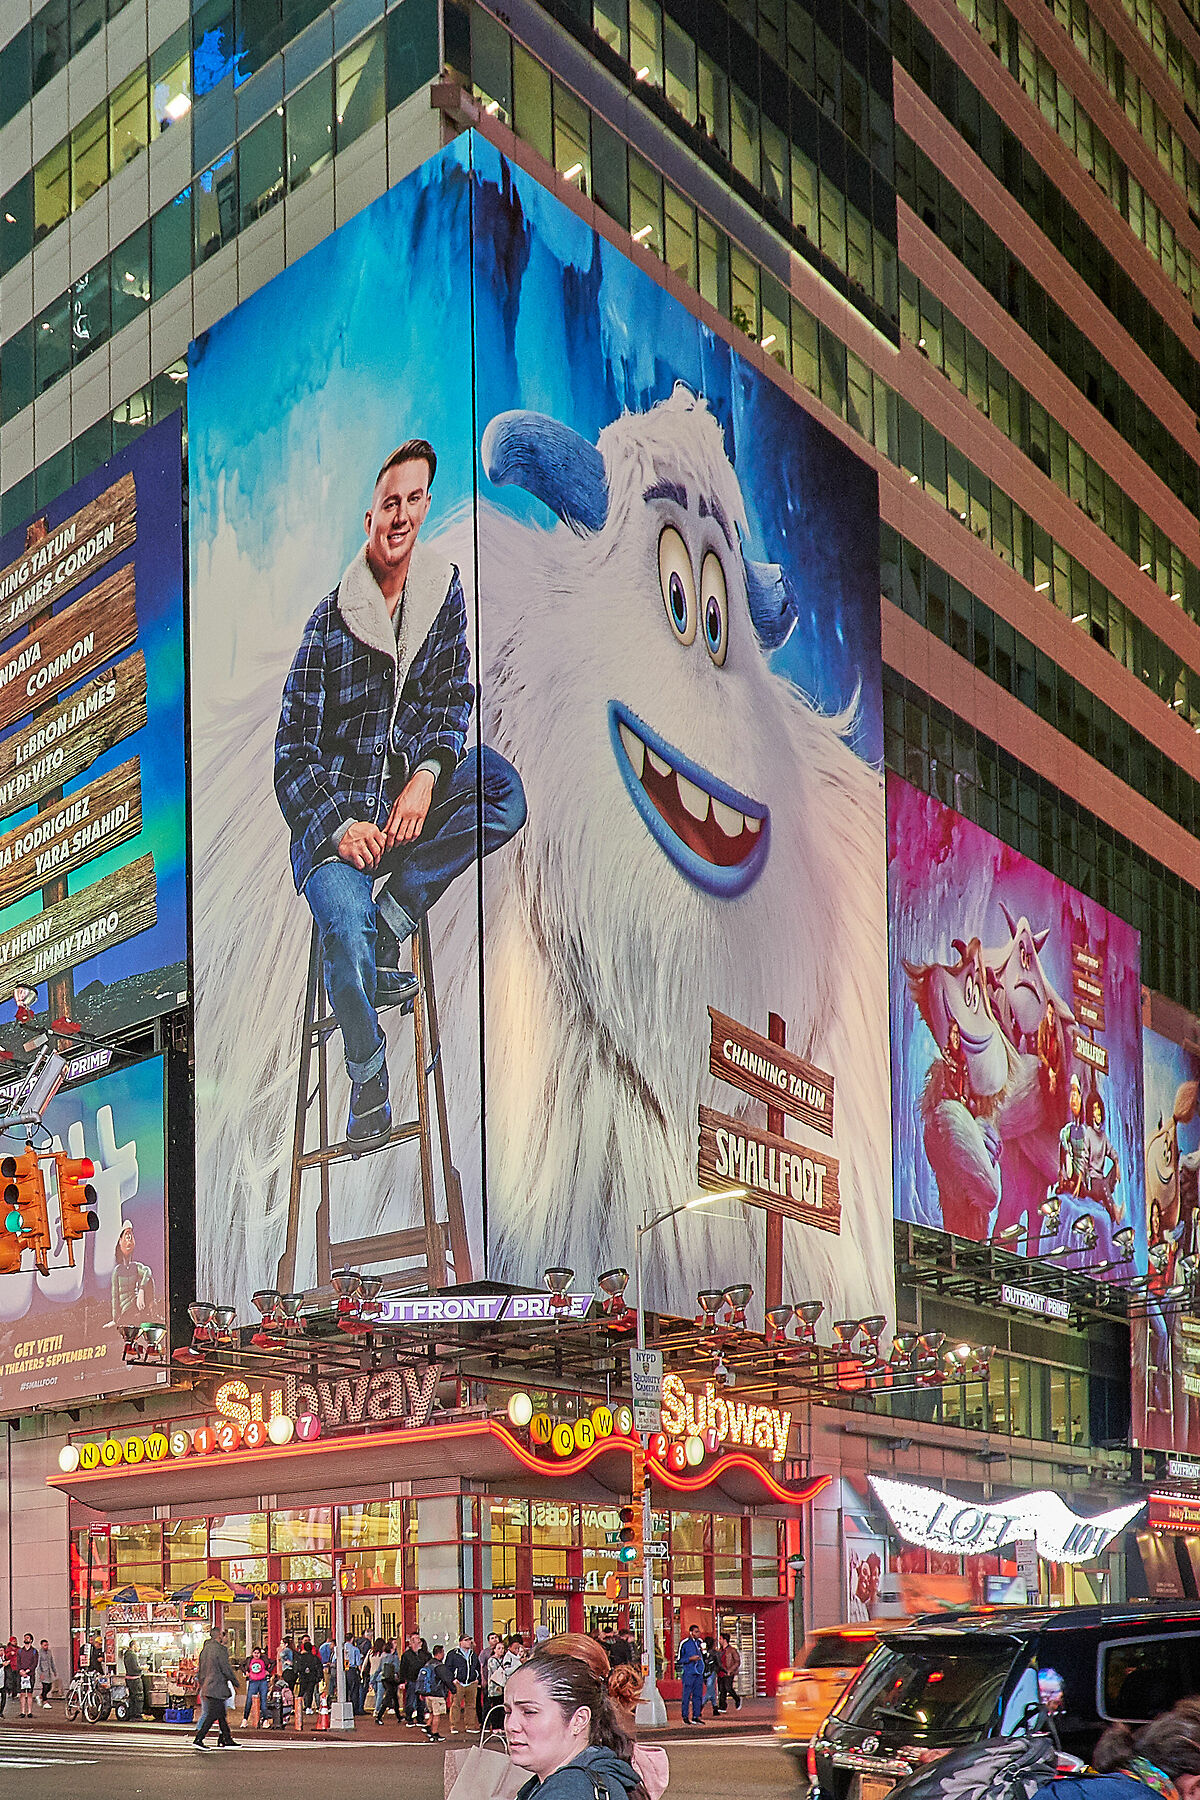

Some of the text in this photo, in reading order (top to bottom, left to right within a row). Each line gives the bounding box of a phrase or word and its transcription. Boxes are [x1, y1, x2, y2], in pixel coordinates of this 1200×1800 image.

[7, 522, 115, 622] JAMES CORDEN
[32, 523, 77, 574] TATUM
[26, 632, 95, 697] COMMON
[68, 679, 116, 729] JAMES
[14, 796, 91, 859] RODRIGUEZ
[34, 801, 130, 877] YARA SHAHIDI
[11, 916, 54, 957] HENRY
[31, 910, 119, 976] JIMMY TATRO
[70, 1051, 109, 1077] PRIME
[722, 1038, 827, 1112] CHANNING TATUM
[1076, 1036, 1106, 1067] SMALLFOOT
[715, 1127, 827, 1210] SMALLFOOT
[363, 1298, 585, 1320] UTFRONT PRIE
[1004, 1287, 1069, 1317] OUTFRONT PRIME
[5, 1357, 45, 1376] THEATERS
[46, 1346, 94, 1369] SEPTEMBER
[94, 1344, 108, 1358] 28
[14, 1334, 64, 1359] GET YETI!
[636, 1352, 657, 1363] NYPD
[19, 1376, 59, 1392] #SMALLFOOT
[215, 1364, 443, 1431] Subway
[83, 1416, 313, 1464] N Q R W S 1 2 3 7
[536, 1421, 550, 1438] N
[560, 1431, 573, 1449] Q
[582, 1425, 592, 1443] R
[599, 1415, 613, 1432] W
[620, 1411, 630, 1430] S
[658, 1437, 667, 1456] 2
[675, 1445, 685, 1466] 3
[708, 1428, 717, 1448] 7
[661, 1374, 792, 1462] Subway
[1171, 1461, 1200, 1478] OUTFRONT
[926, 1501, 1021, 1547] LOFT
